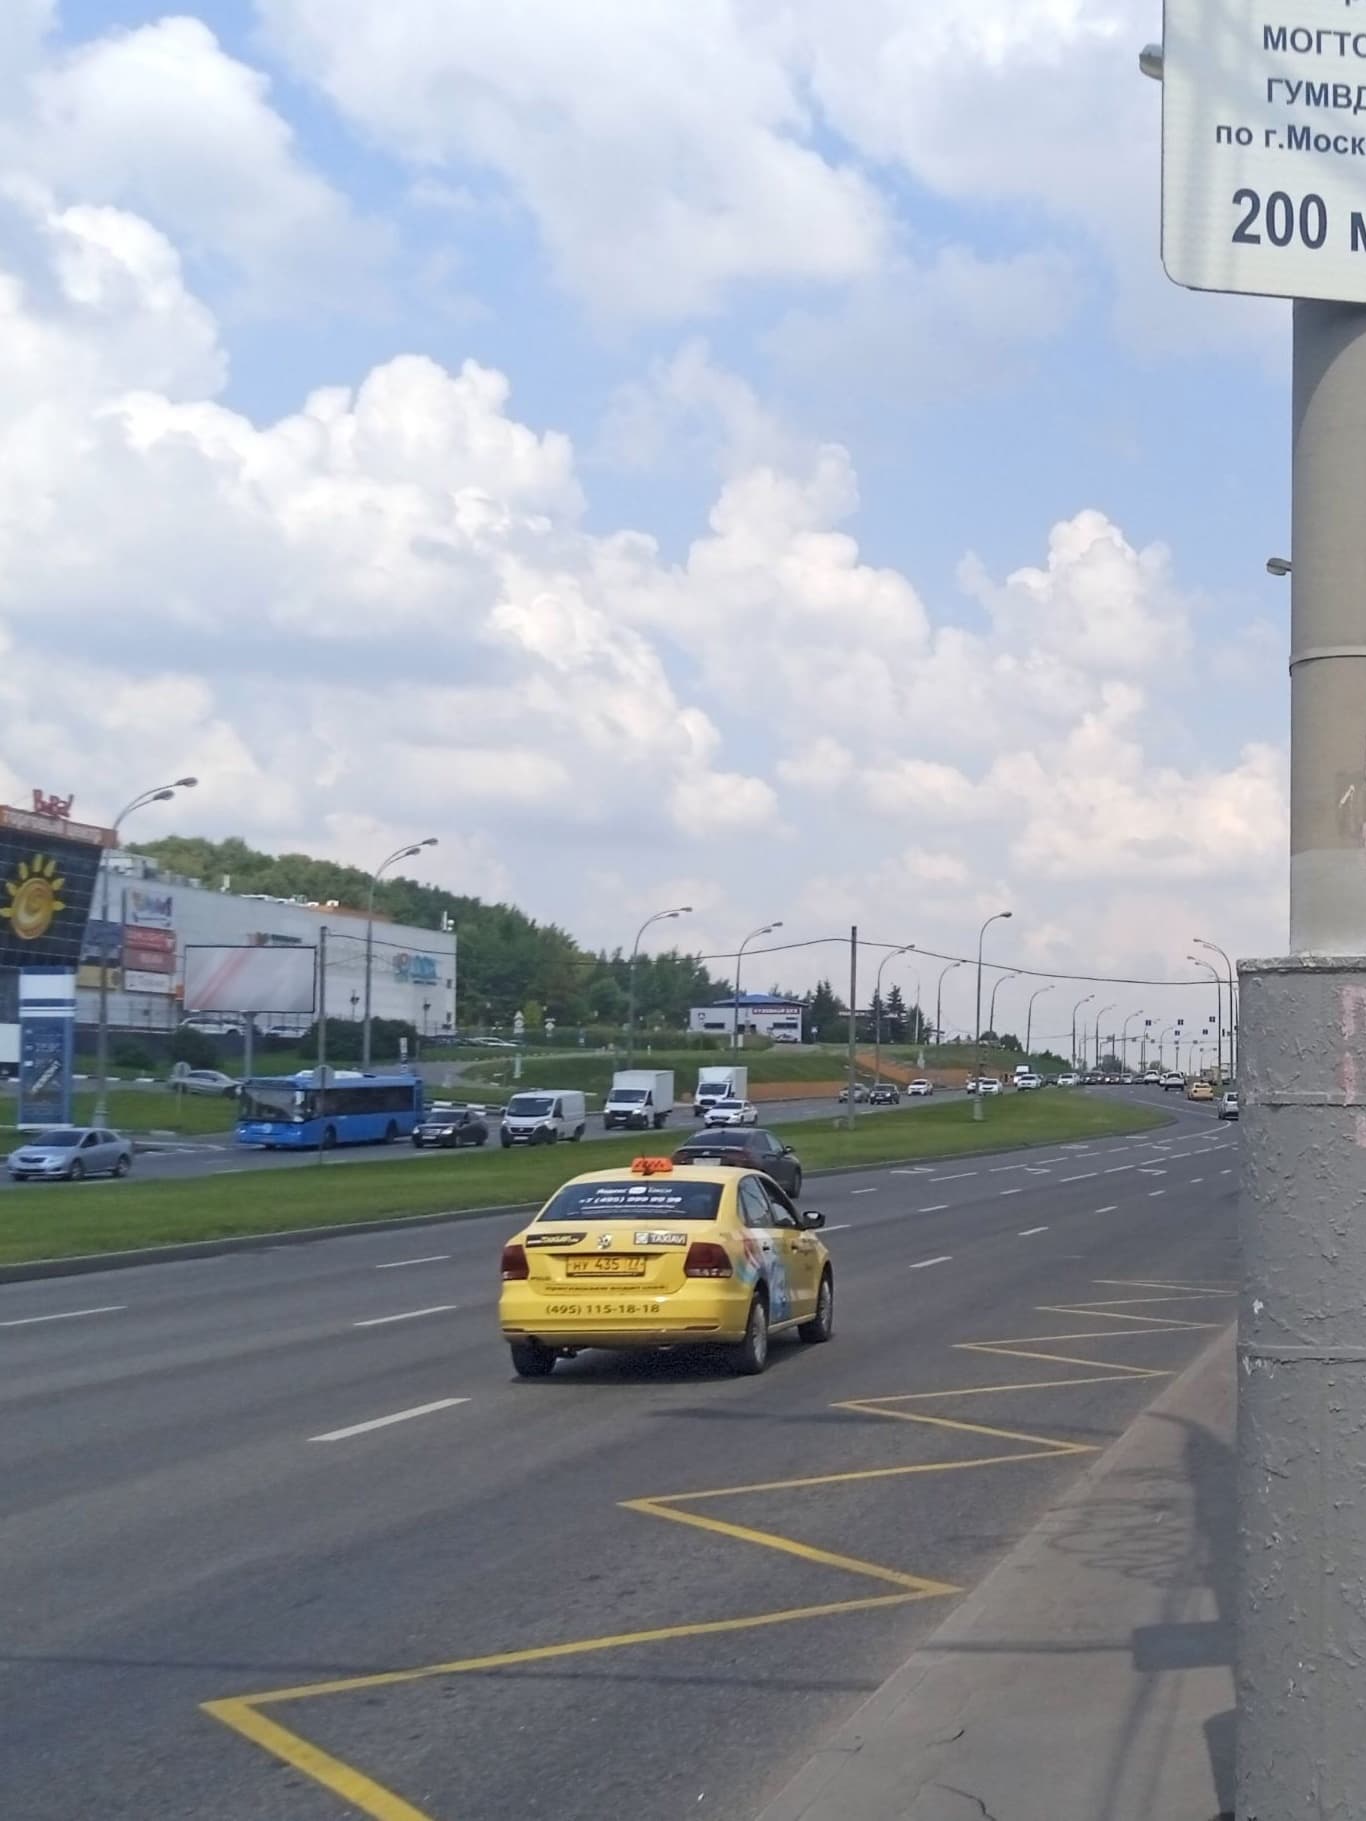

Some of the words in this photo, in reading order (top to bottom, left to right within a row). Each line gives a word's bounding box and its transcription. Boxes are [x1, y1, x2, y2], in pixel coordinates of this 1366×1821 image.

[1216, 124, 1253, 146] по
[1231, 188, 1328, 249] 200
[594, 1258, 619, 1270] 435
[546, 1304, 581, 1315] (495)
[586, 1304, 660, 1314] 115-18-18
